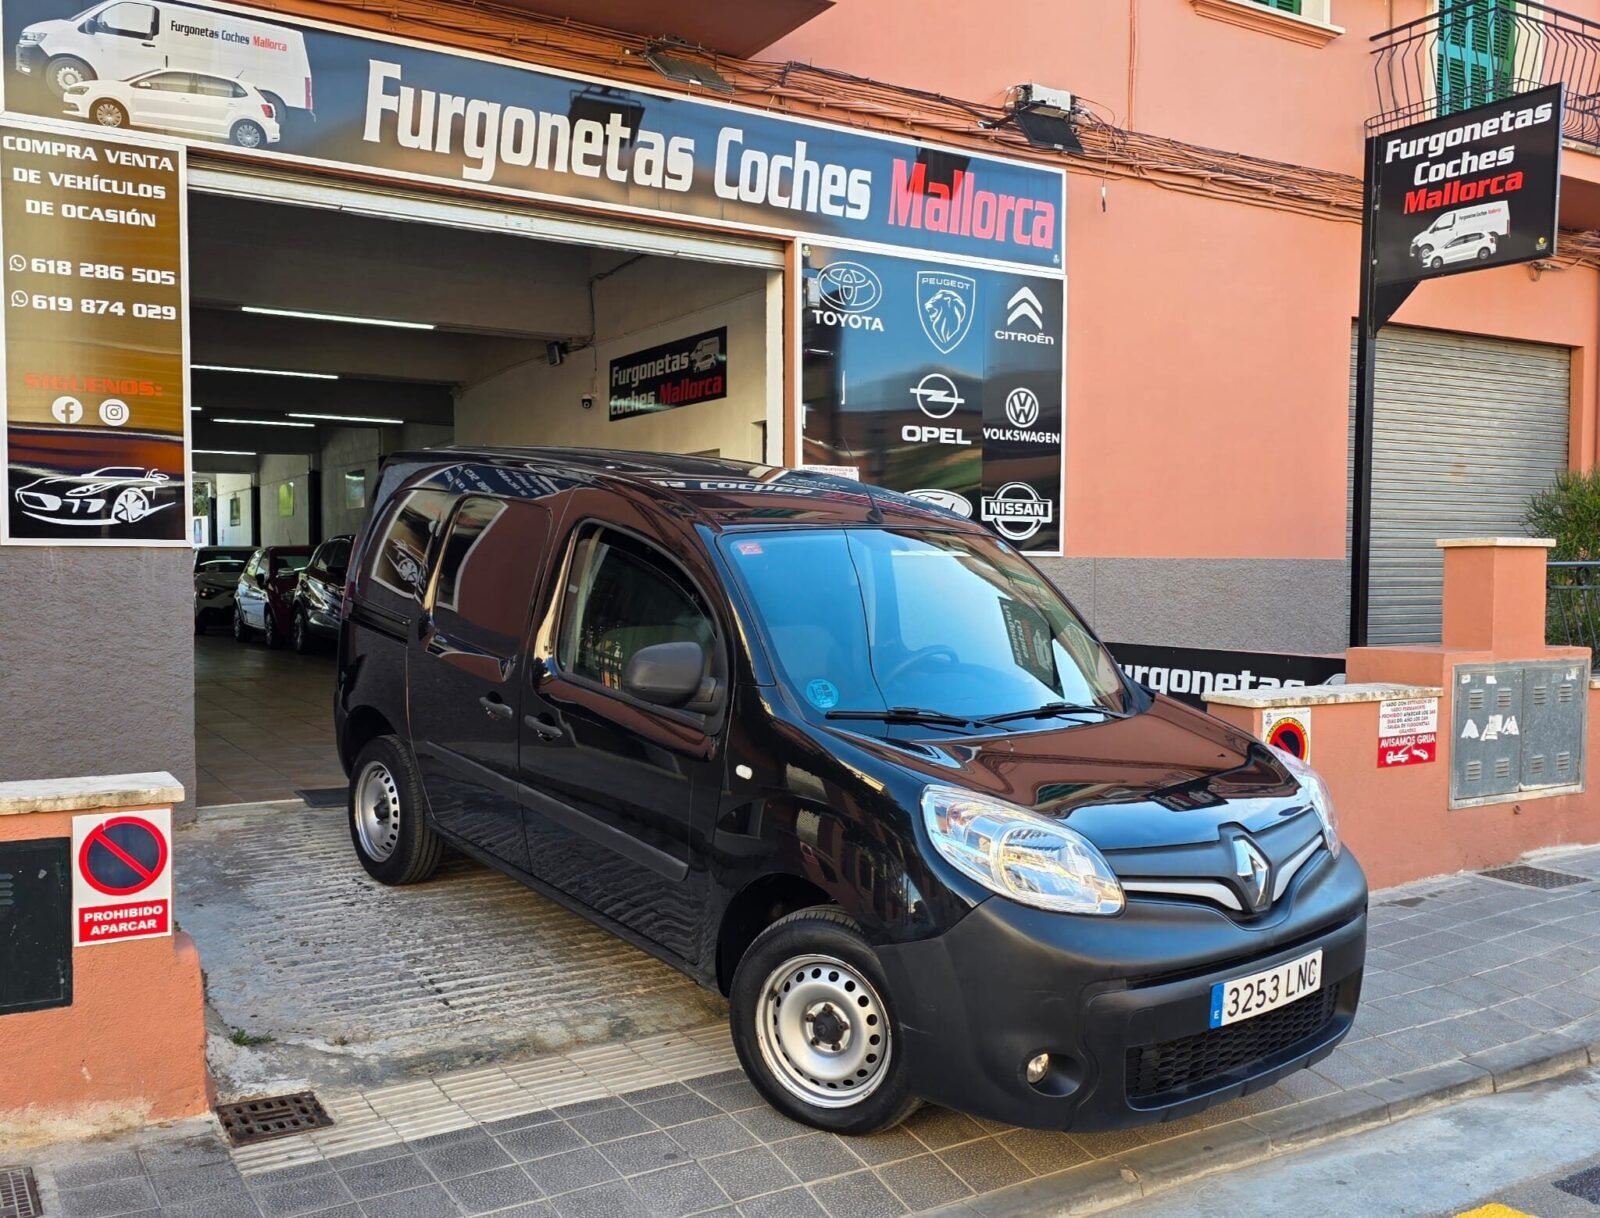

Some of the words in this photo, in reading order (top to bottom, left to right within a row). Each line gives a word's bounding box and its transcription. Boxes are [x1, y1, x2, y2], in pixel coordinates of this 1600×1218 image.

[171, 20, 219, 37] Furgonetas
[221, 30, 250, 45] Coches
[253, 36, 287, 51] Mallorca
[1385, 102, 1553, 163] Furgonetas
[3, 135, 97, 162] COMPRA
[104, 148, 174, 171] VENTA
[363, 59, 695, 192] Furgonetas
[714, 126, 872, 220] Coches
[887, 158, 1055, 249] Mallorca
[1414, 145, 1515, 186] Coches
[13, 167, 41, 184] DE
[49, 171, 166, 199] VEHÍCULOS
[1403, 171, 1524, 215] Mallorca
[26, 200, 54, 216] DE
[61, 203, 156, 227] OCASIÓN
[31, 258, 72, 276] 618
[80, 262, 124, 281] 286
[132, 267, 175, 285] 505
[921, 277, 971, 290] PEUGEOT
[32, 295, 72, 311] 619
[80, 299, 125, 316] 874
[132, 303, 176, 320] 029
[812, 309, 884, 332] TOYOTA
[612, 352, 689, 388] Furgonetas
[610, 391, 655, 415] Coches
[660, 375, 722, 404] Mallorca
[901, 425, 972, 445] OPEL
[982, 427, 1061, 444] VOLKSWAGEN
[989, 502, 1044, 516] NISSAN
[1380, 736, 1416, 748] AVISAMOS
[1416, 734, 1436, 744] GRUA
[84, 905, 163, 923] PROHIBIDO
[90, 919, 157, 936] APARCAR
[1227, 974, 1280, 1017] 3253
[1286, 958, 1317, 998] LNC
[1213, 1010, 1220, 1020] E
